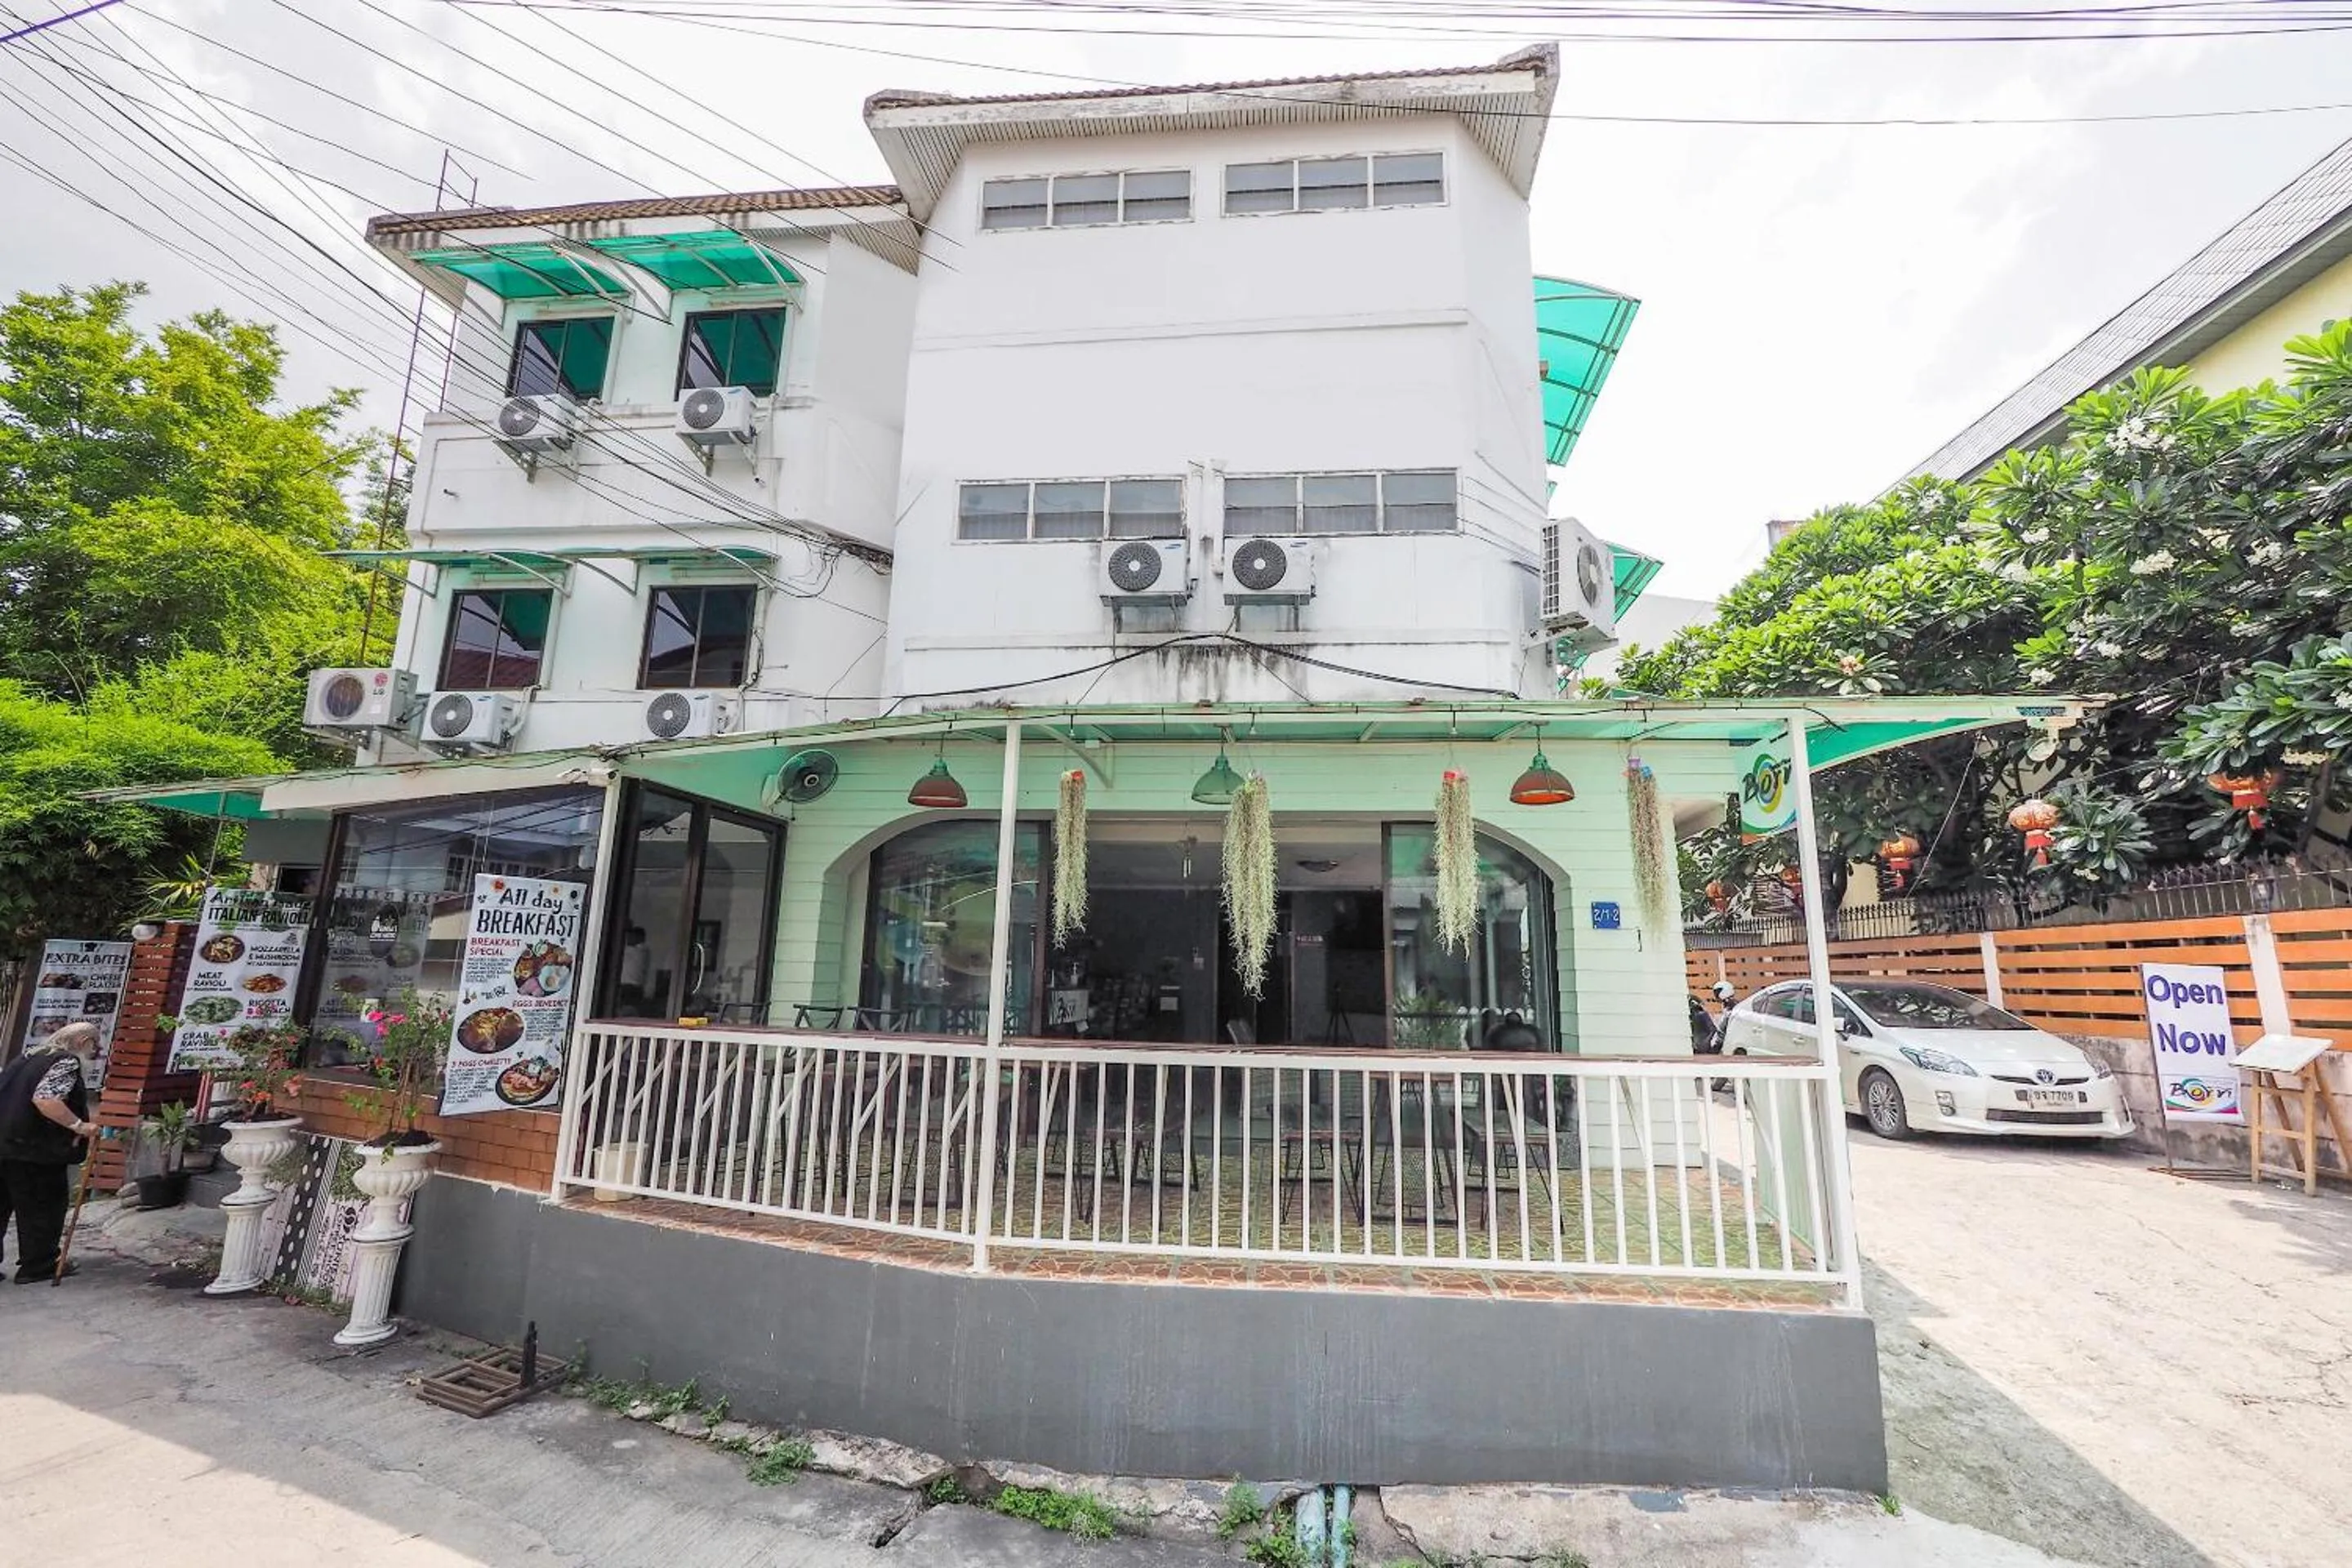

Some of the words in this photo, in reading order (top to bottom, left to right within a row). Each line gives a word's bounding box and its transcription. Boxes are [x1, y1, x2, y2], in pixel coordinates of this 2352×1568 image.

[499, 888, 528, 906] All
[532, 890, 564, 915] day
[208, 906, 257, 922] ITALIAN
[476, 909, 577, 938] BREAKFAST
[470, 937, 521, 947] BREAKFAST
[470, 947, 504, 956] SPECIAL
[45, 952, 91, 964] EXTRA
[2147, 974, 2225, 1009] Open
[2156, 1022, 2226, 1056] Now
